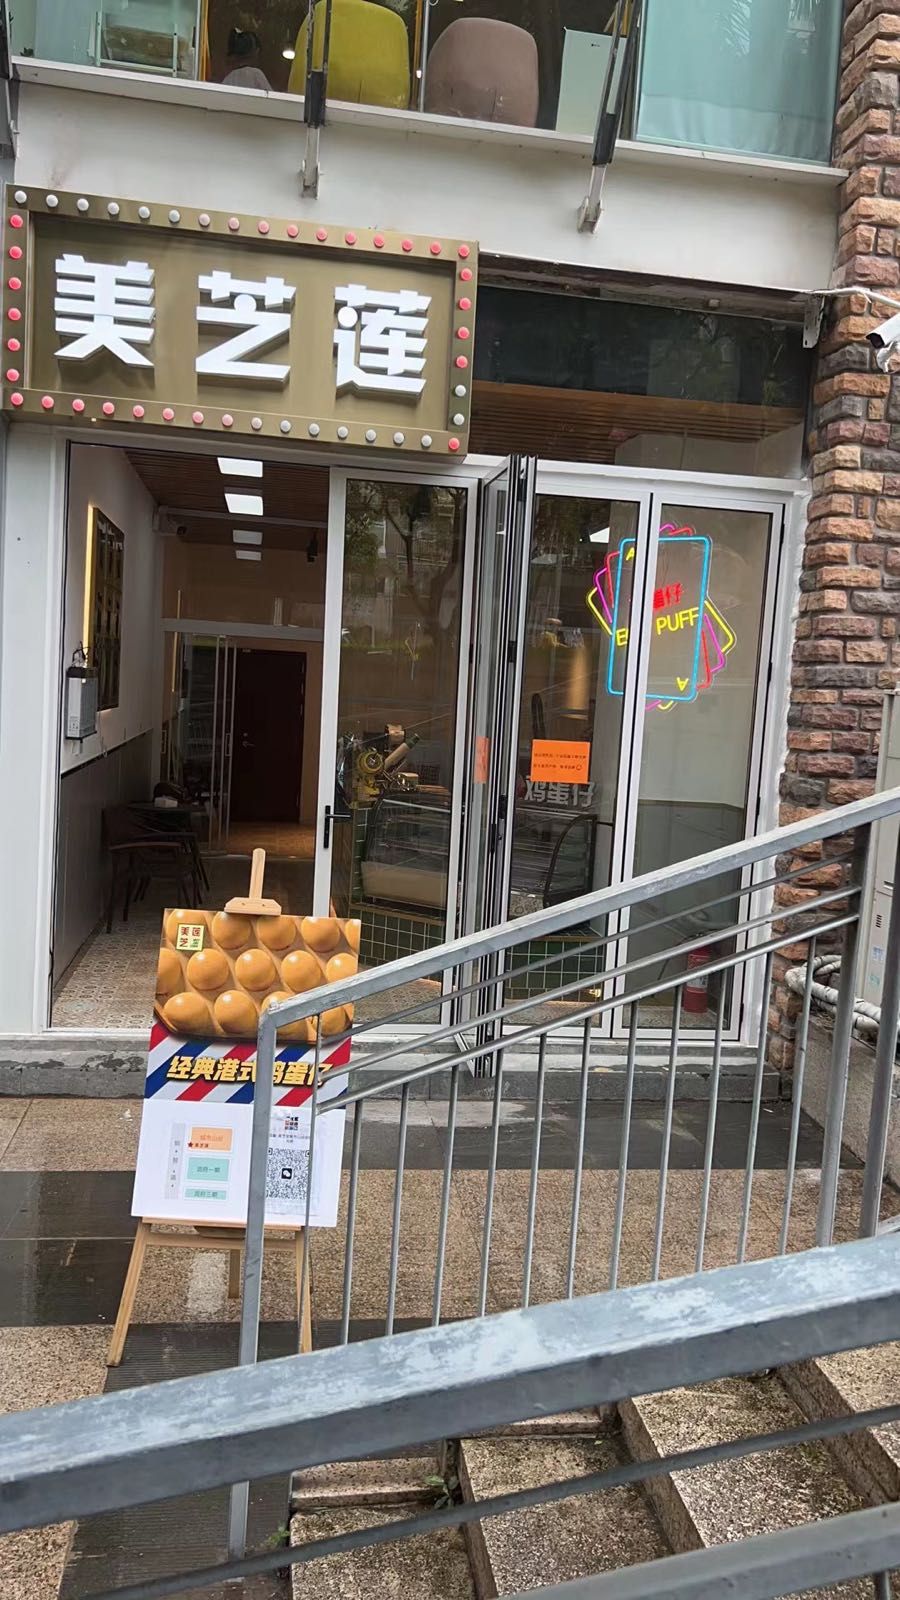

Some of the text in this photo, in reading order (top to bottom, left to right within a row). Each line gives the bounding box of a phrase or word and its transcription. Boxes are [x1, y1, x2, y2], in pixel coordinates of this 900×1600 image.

[53, 253, 433, 400] 美芝莲
[656, 606, 699, 635] PUFF
[524, 776, 596, 808] 鸡蛋仔
